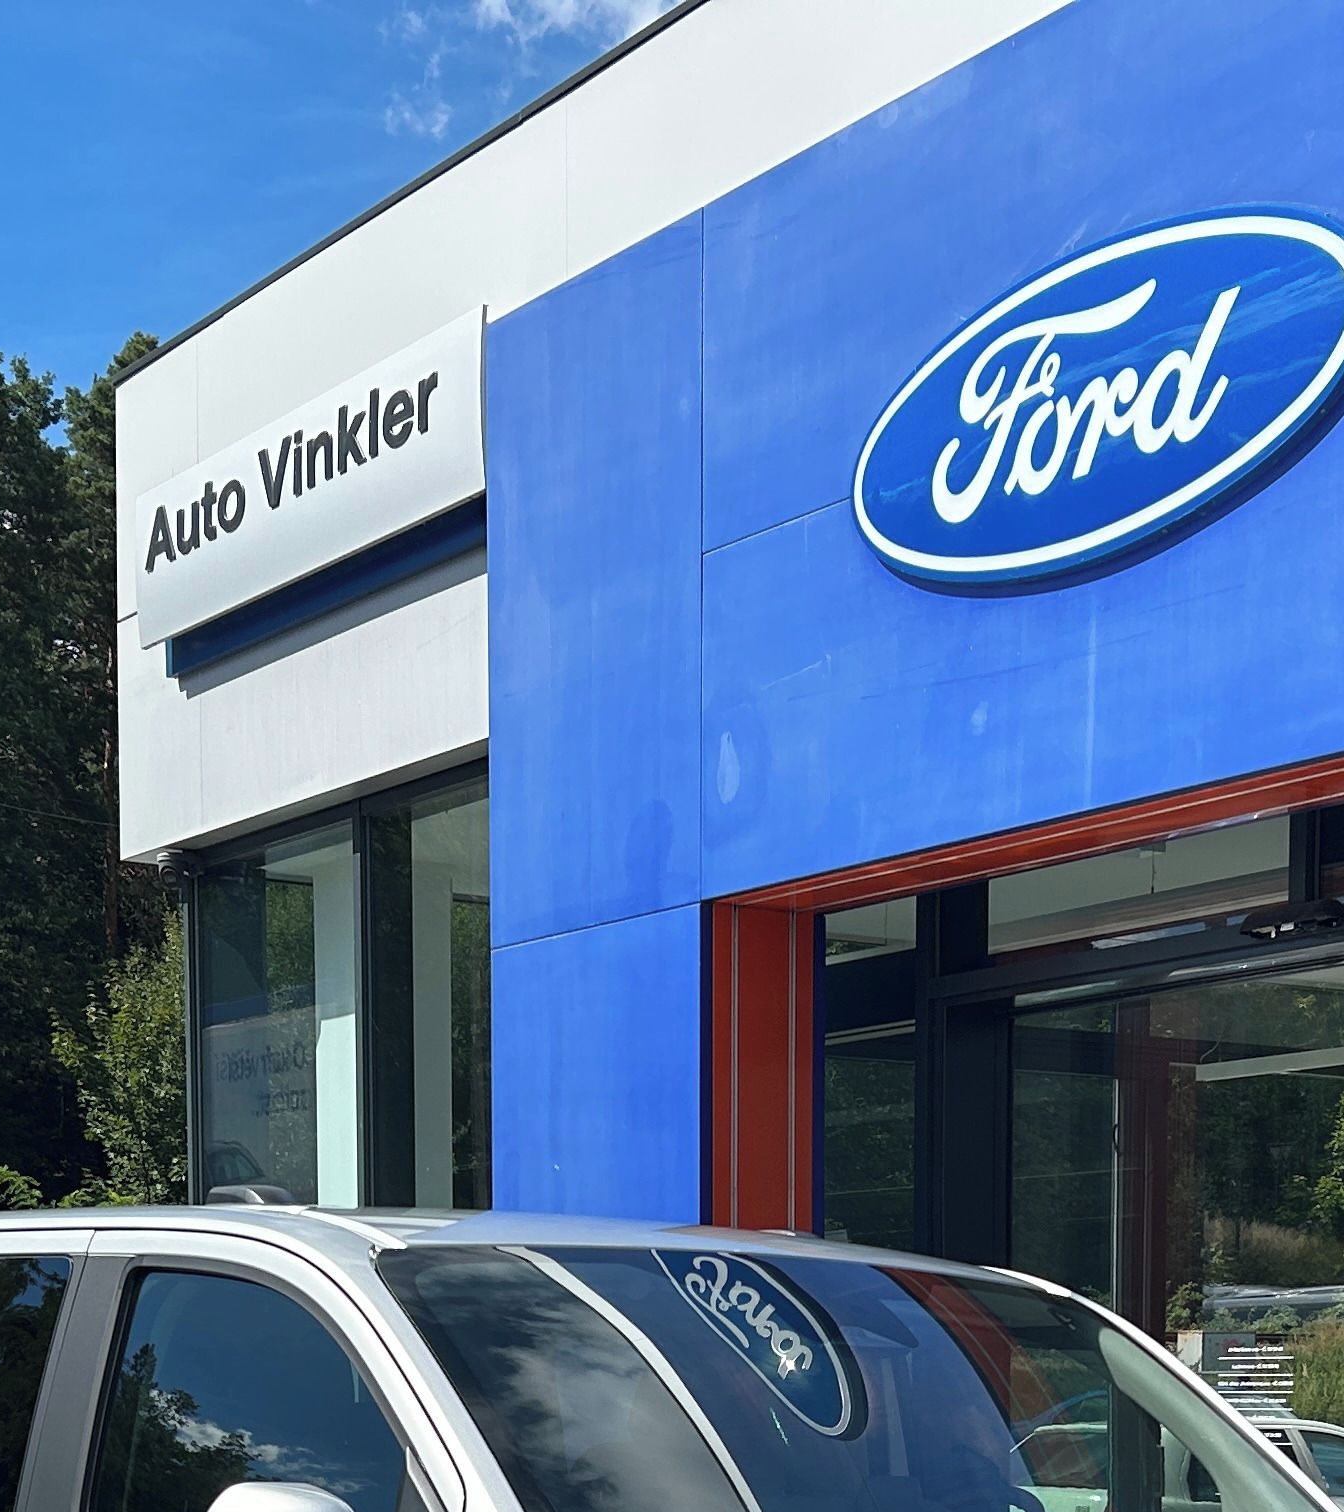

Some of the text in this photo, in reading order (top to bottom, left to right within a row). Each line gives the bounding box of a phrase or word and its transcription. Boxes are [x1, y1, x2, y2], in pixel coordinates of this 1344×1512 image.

[145, 371, 439, 573] Auto Vinkler
[932, 278, 1240, 523] Ford
